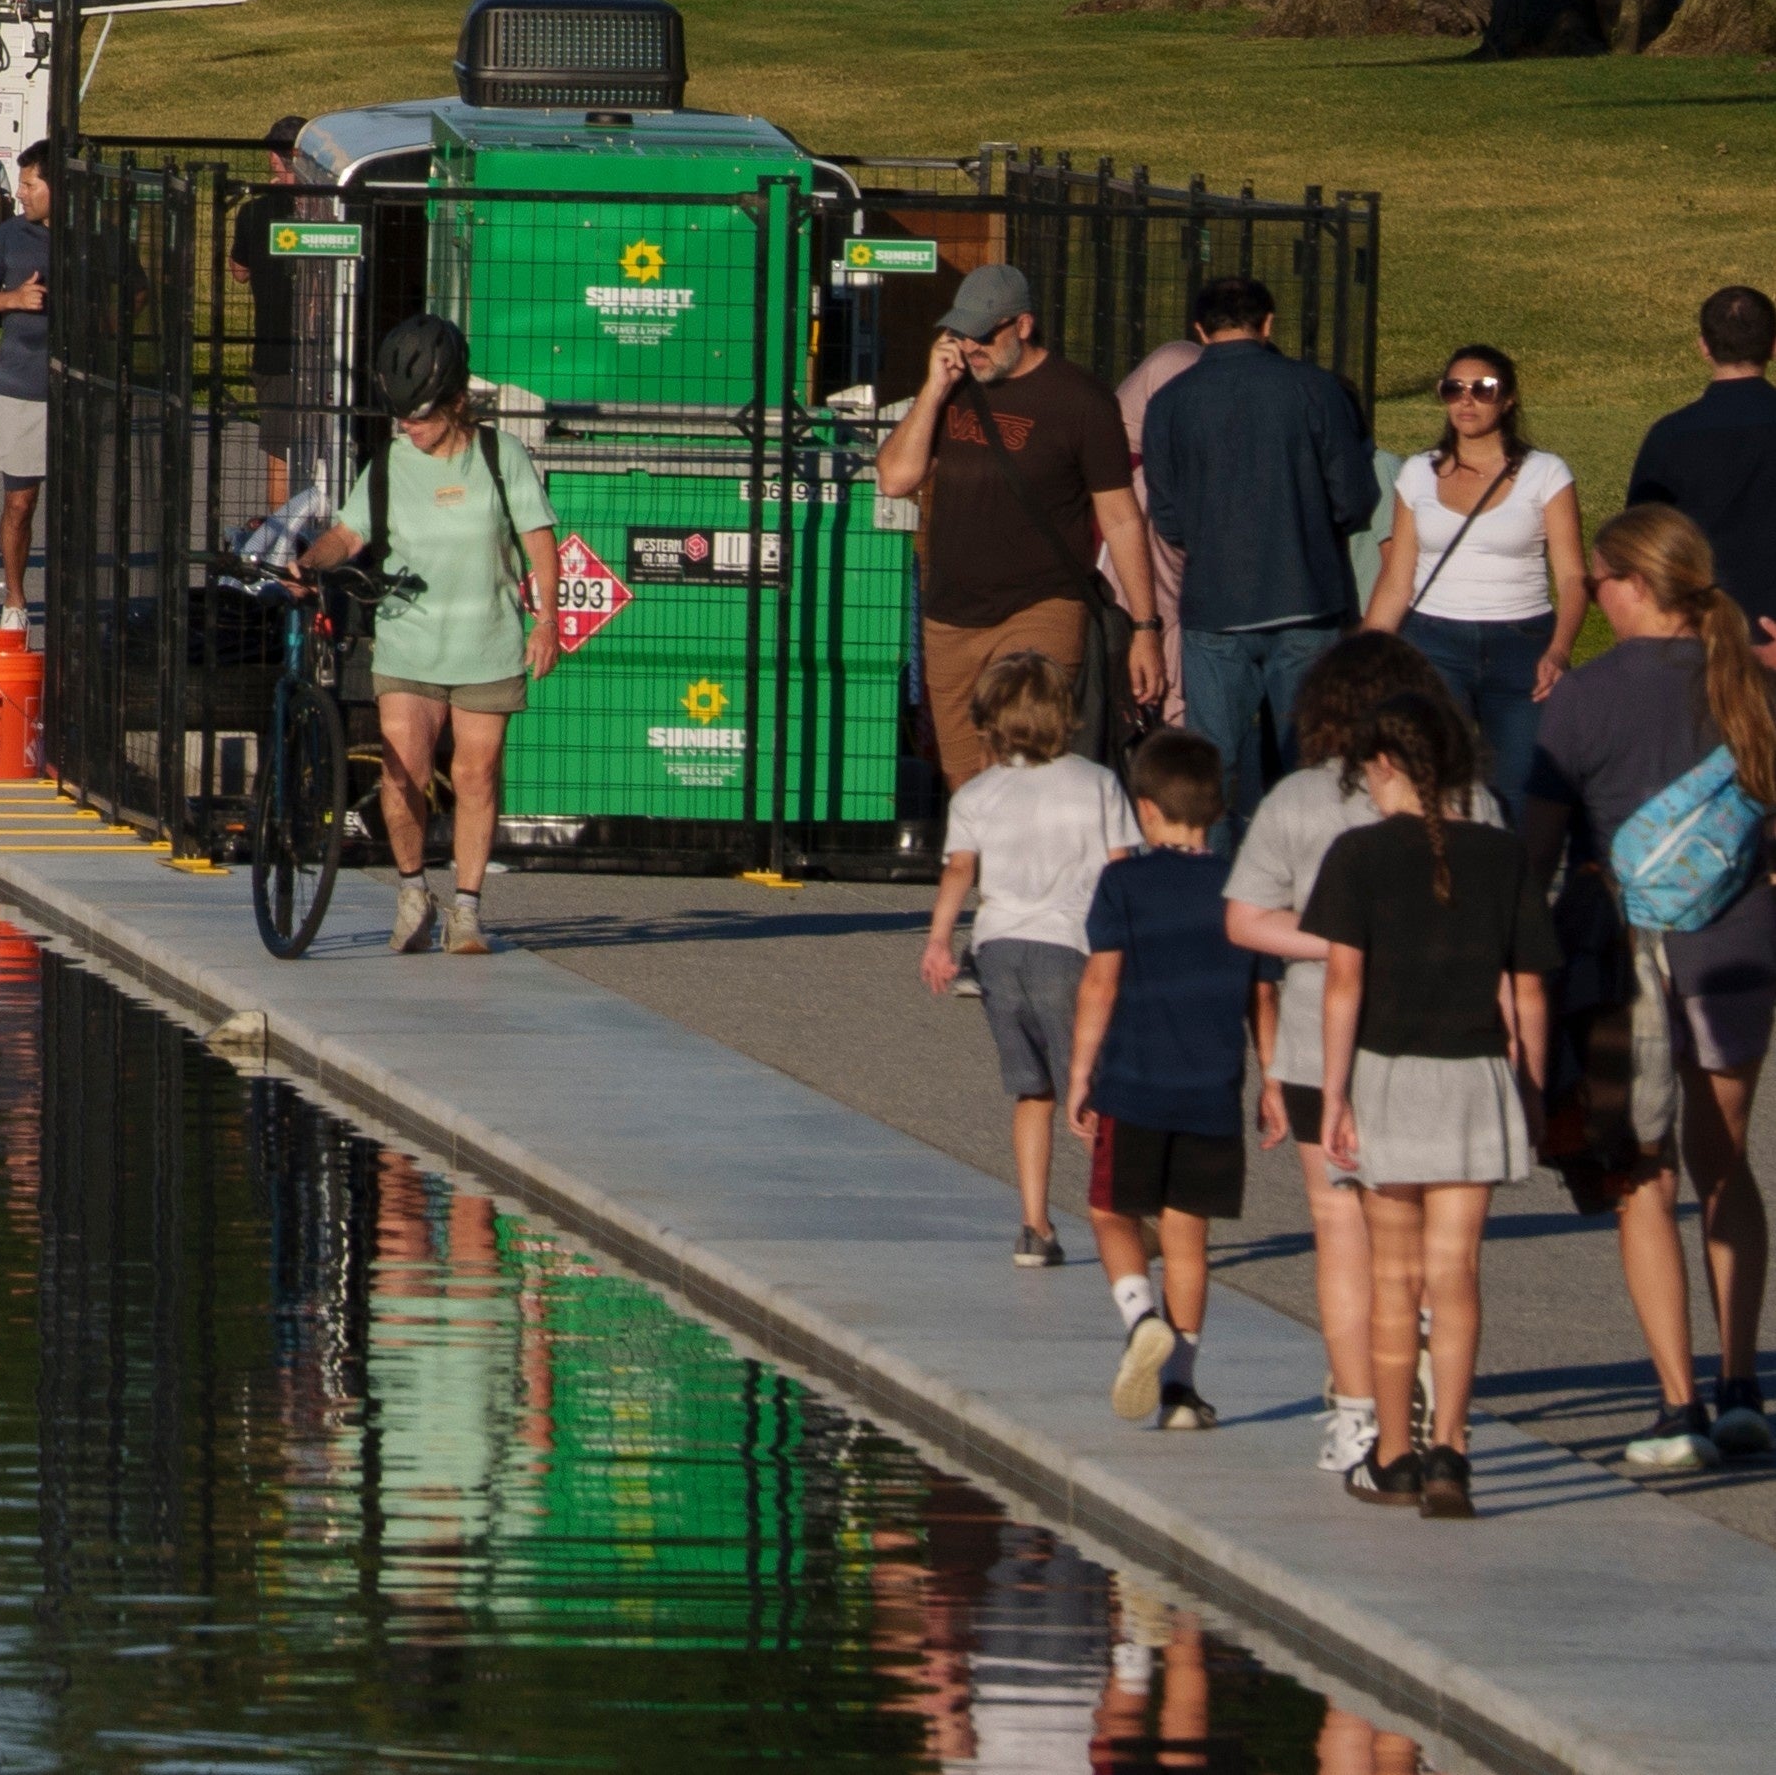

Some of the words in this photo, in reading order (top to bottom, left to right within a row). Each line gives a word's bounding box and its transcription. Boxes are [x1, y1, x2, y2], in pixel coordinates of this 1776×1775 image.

[301, 234, 356, 244] SUNBELT
[874, 250, 931, 261] SUNBELT
[585, 286, 694, 308] SUNBELT
[600, 307, 677, 317] RENTALS
[604, 325, 636, 335] POWER
[947, 405, 1034, 451] VAS
[634, 537, 684, 553] WESTERN
[557, 579, 604, 610] 993
[564, 616, 578, 636] 3
[648, 727, 746, 748] SUNBEL
